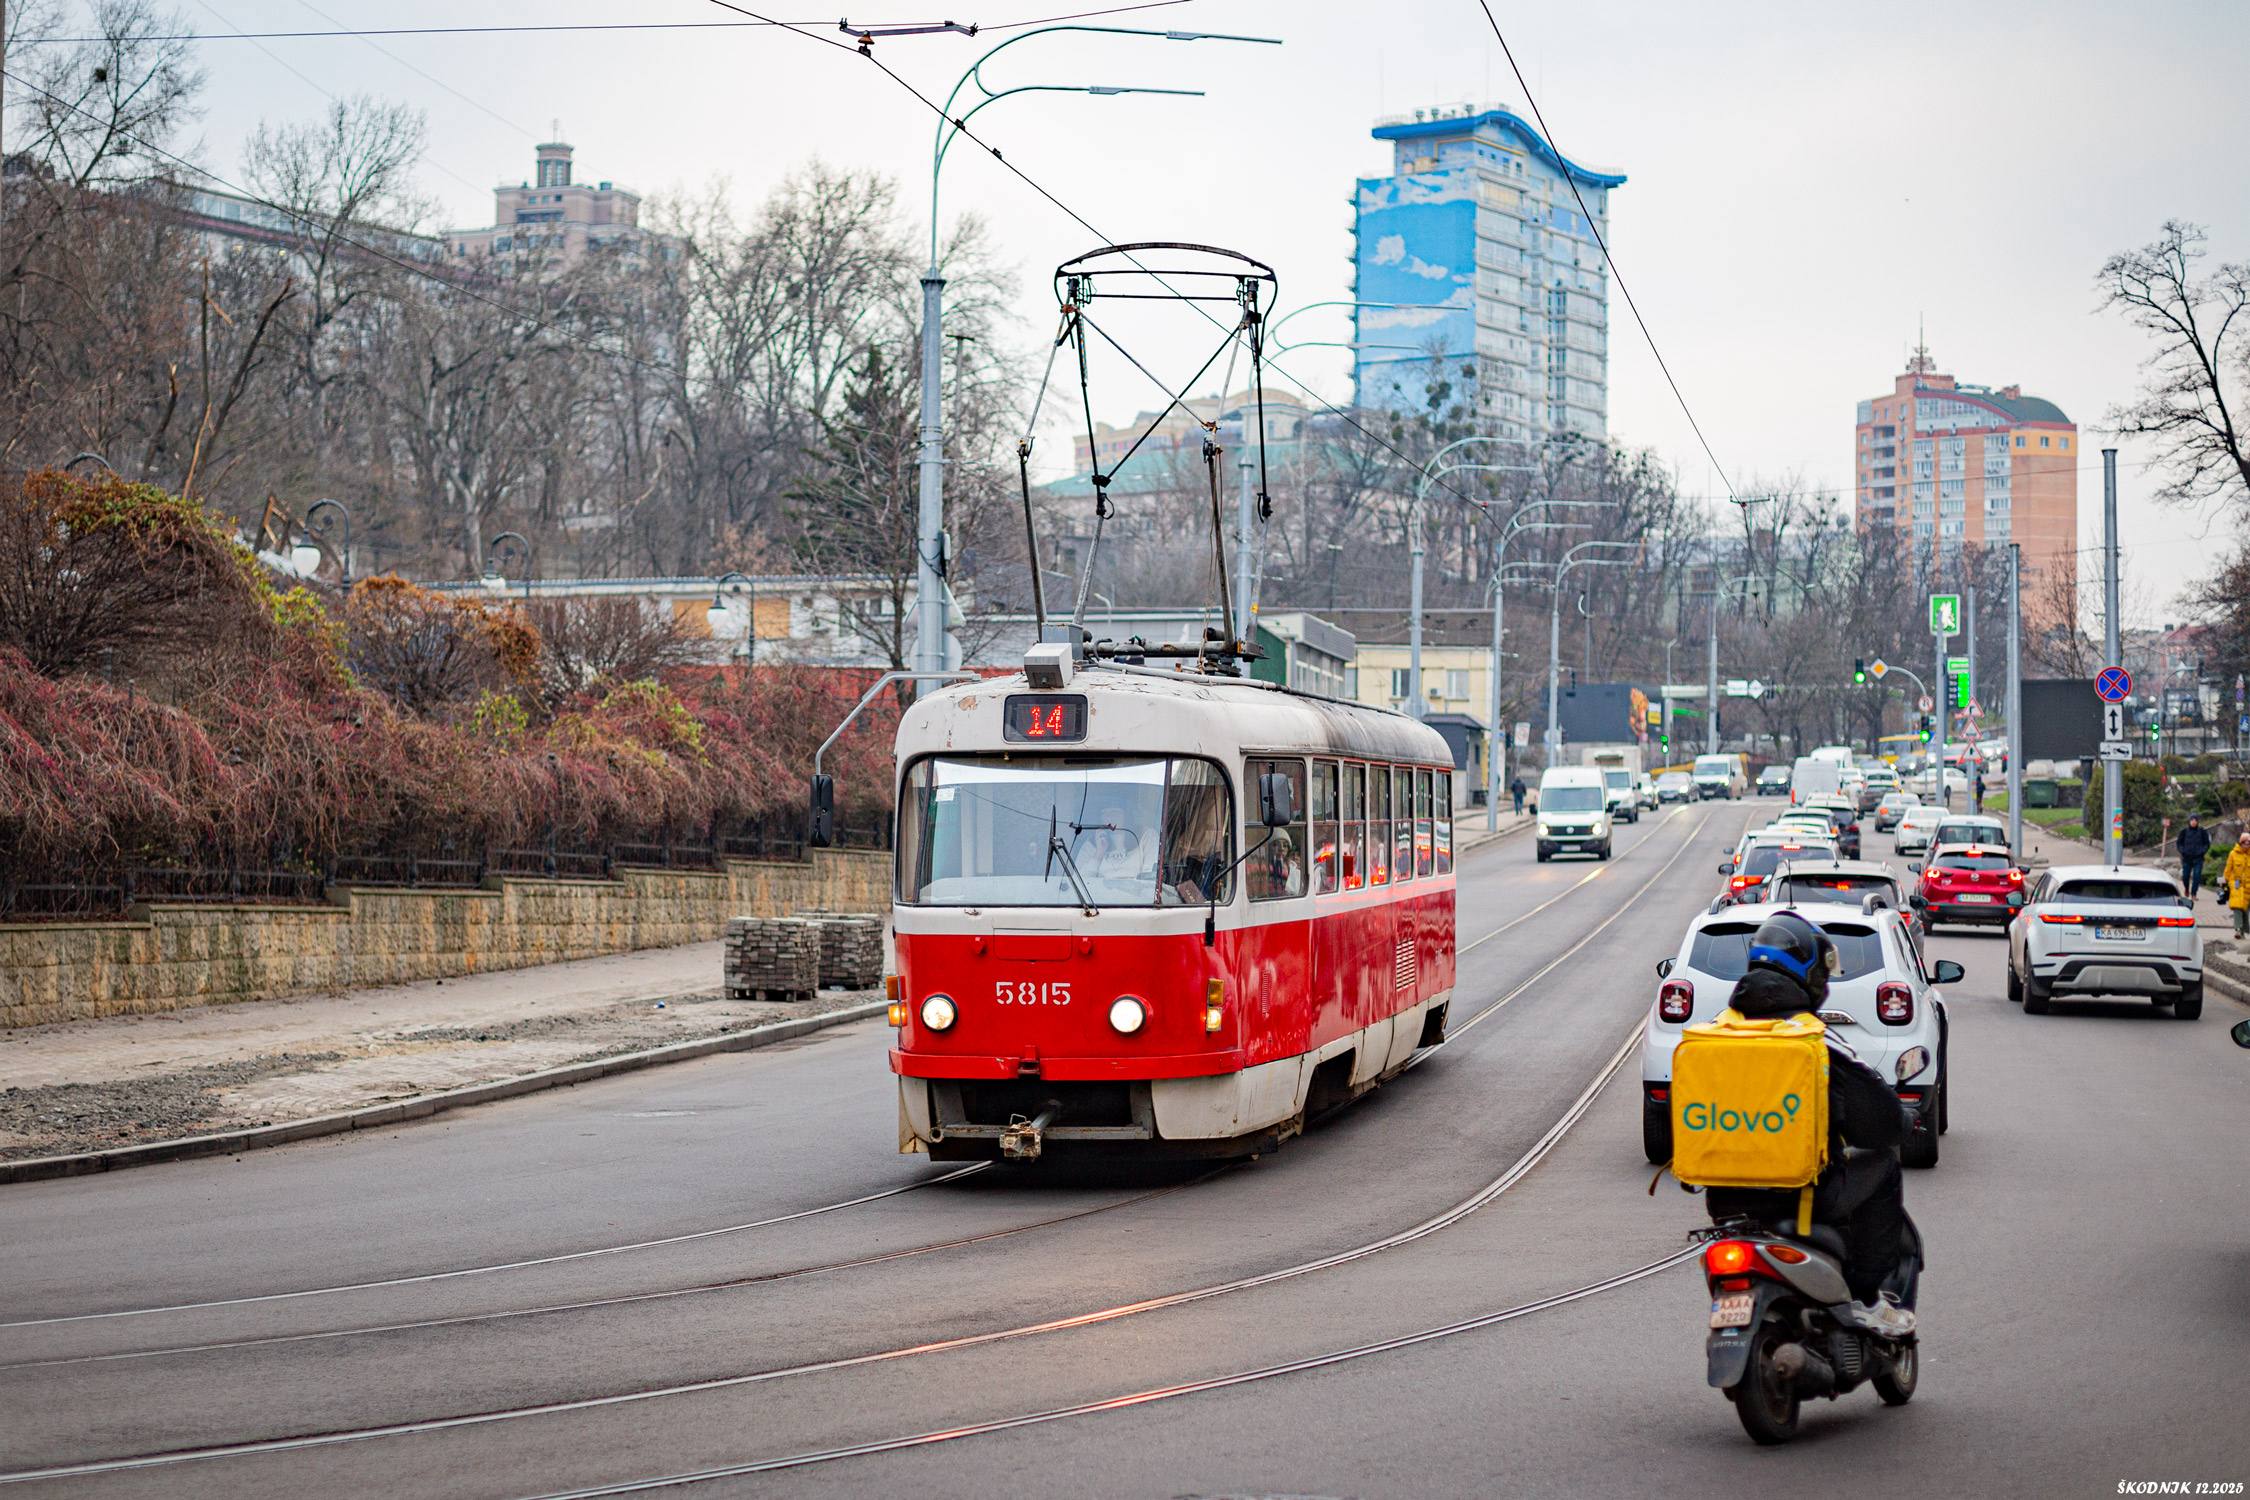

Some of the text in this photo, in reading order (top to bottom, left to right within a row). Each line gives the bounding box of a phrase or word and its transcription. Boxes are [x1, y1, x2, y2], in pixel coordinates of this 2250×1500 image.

[1027, 705, 1062, 736] 14
[996, 981, 1071, 1005] 5815
[1683, 1102, 1784, 1133] Glovo
